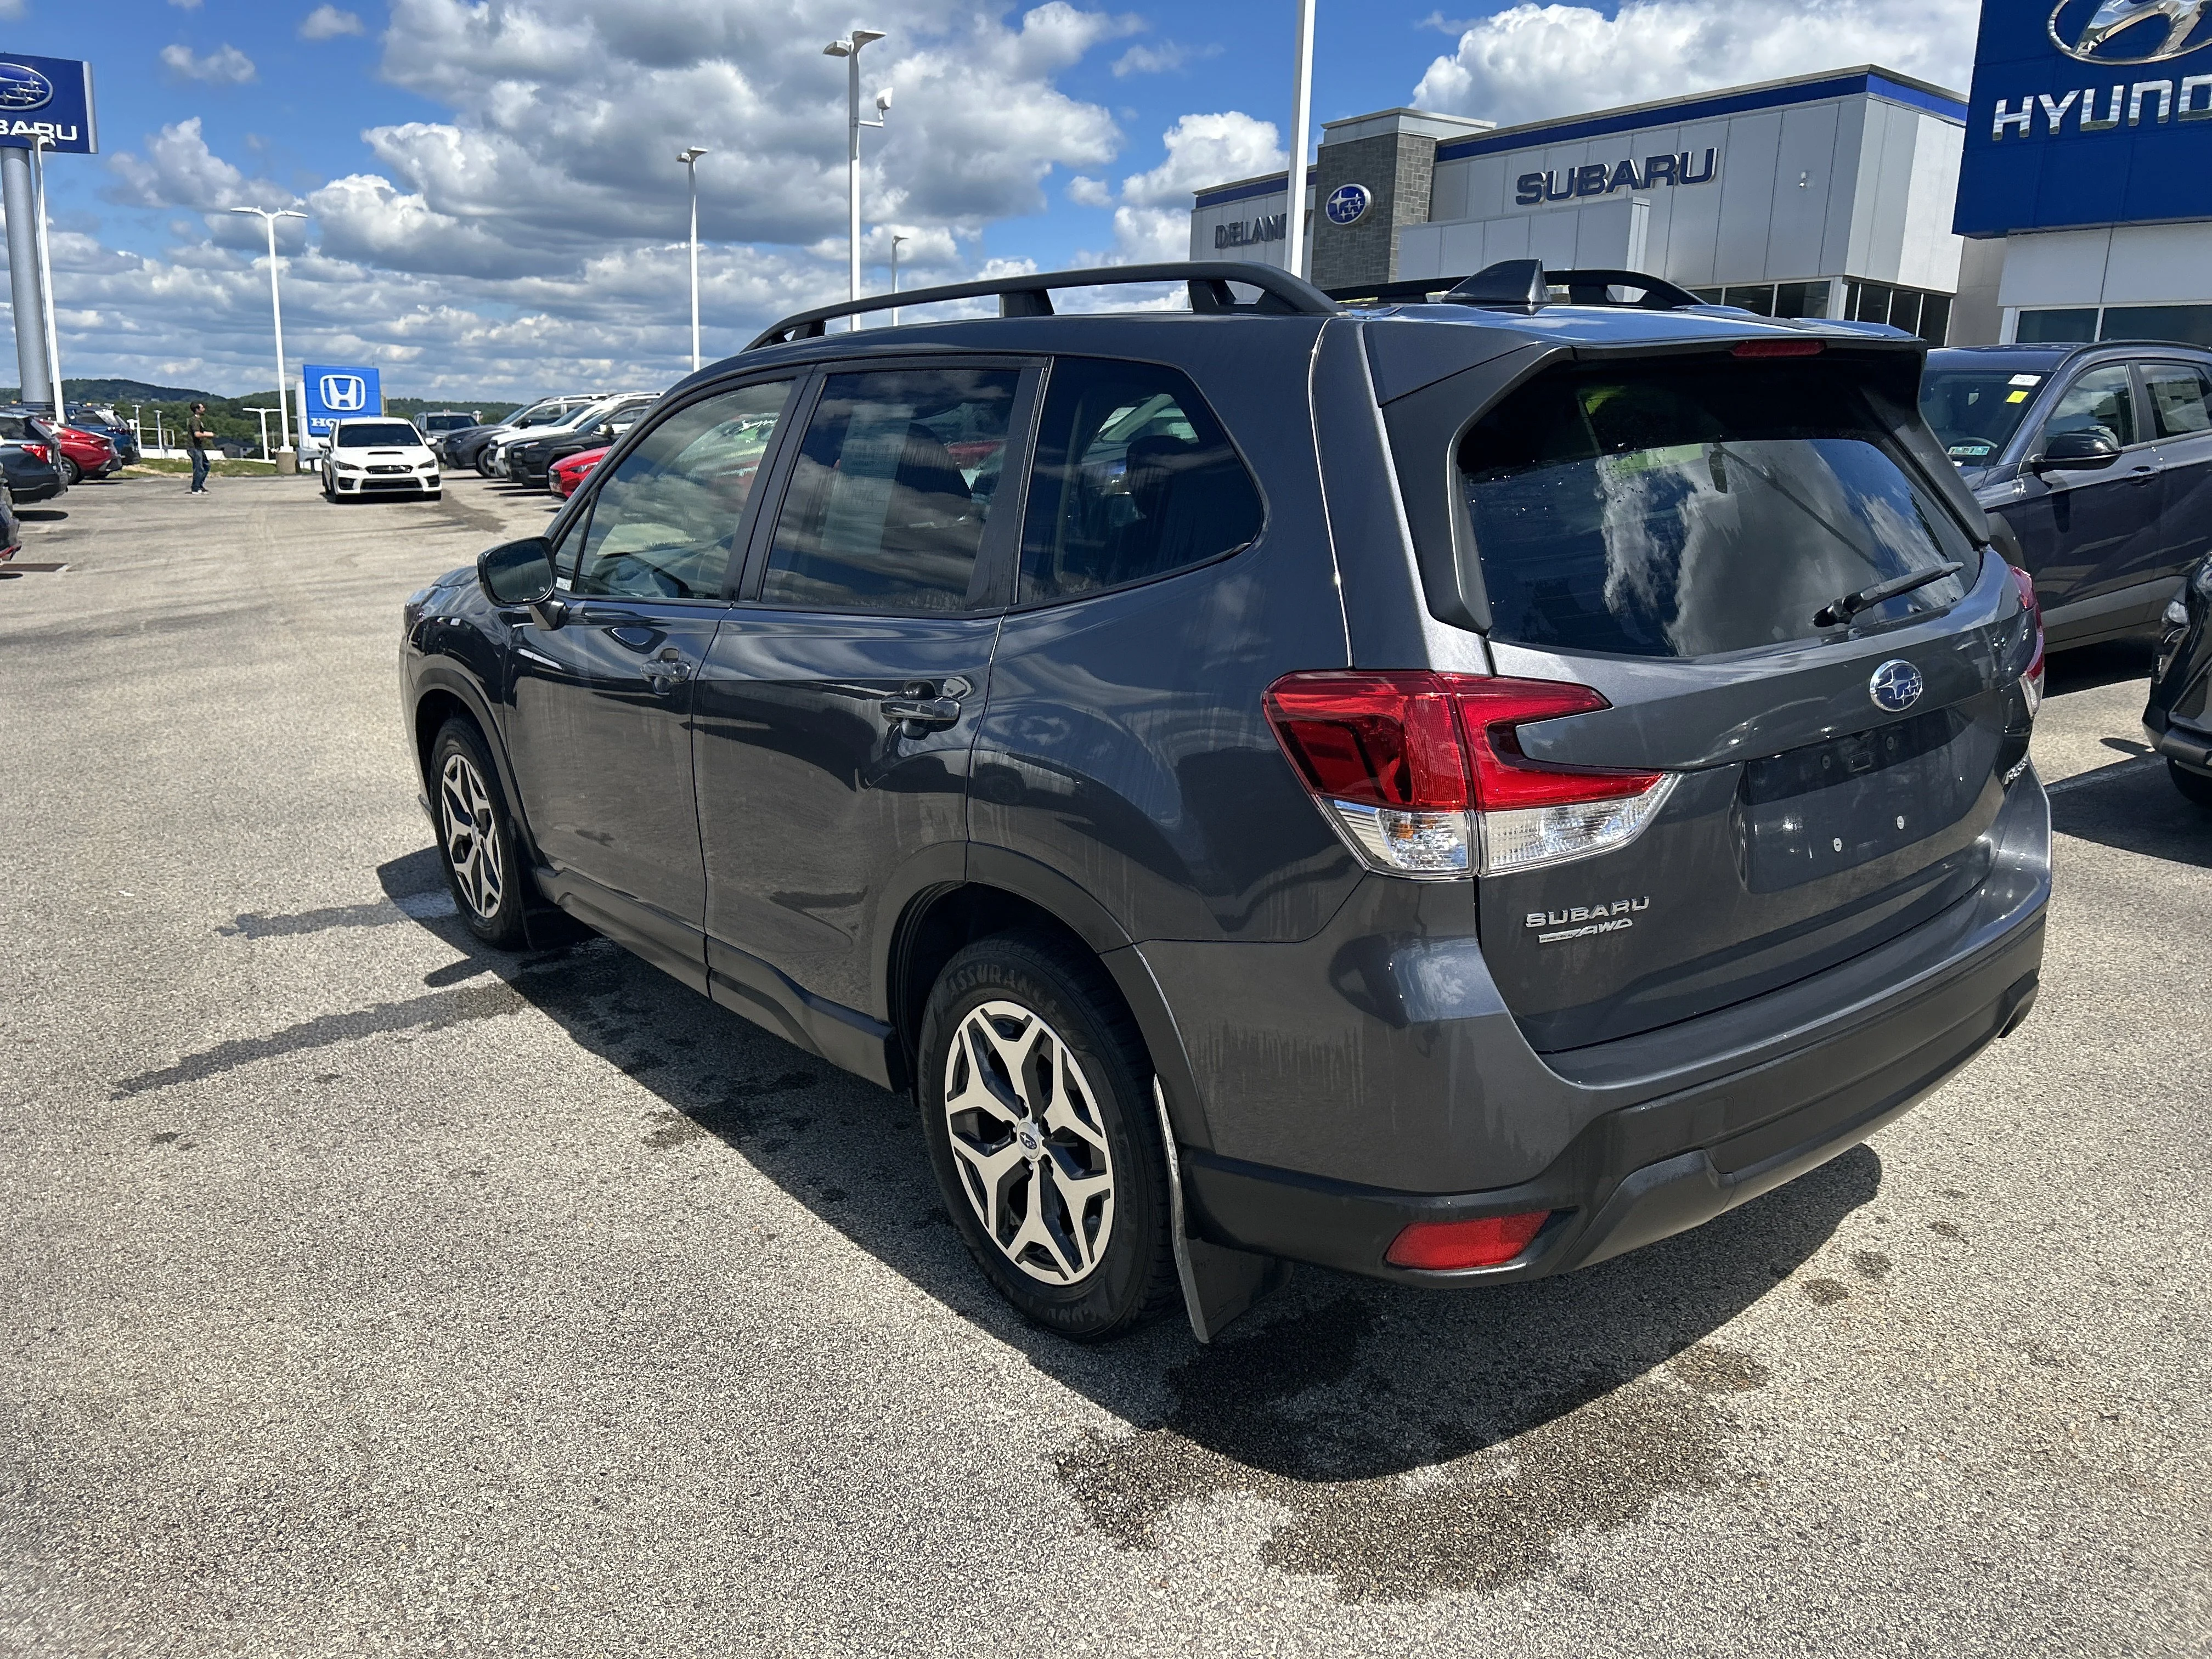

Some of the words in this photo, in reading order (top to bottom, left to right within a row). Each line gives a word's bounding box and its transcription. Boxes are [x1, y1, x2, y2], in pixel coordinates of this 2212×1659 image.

[1516, 147, 1718, 205] SUBARU
[1525, 896, 1650, 928] SUBARU
[1575, 918, 1633, 938] AWD
